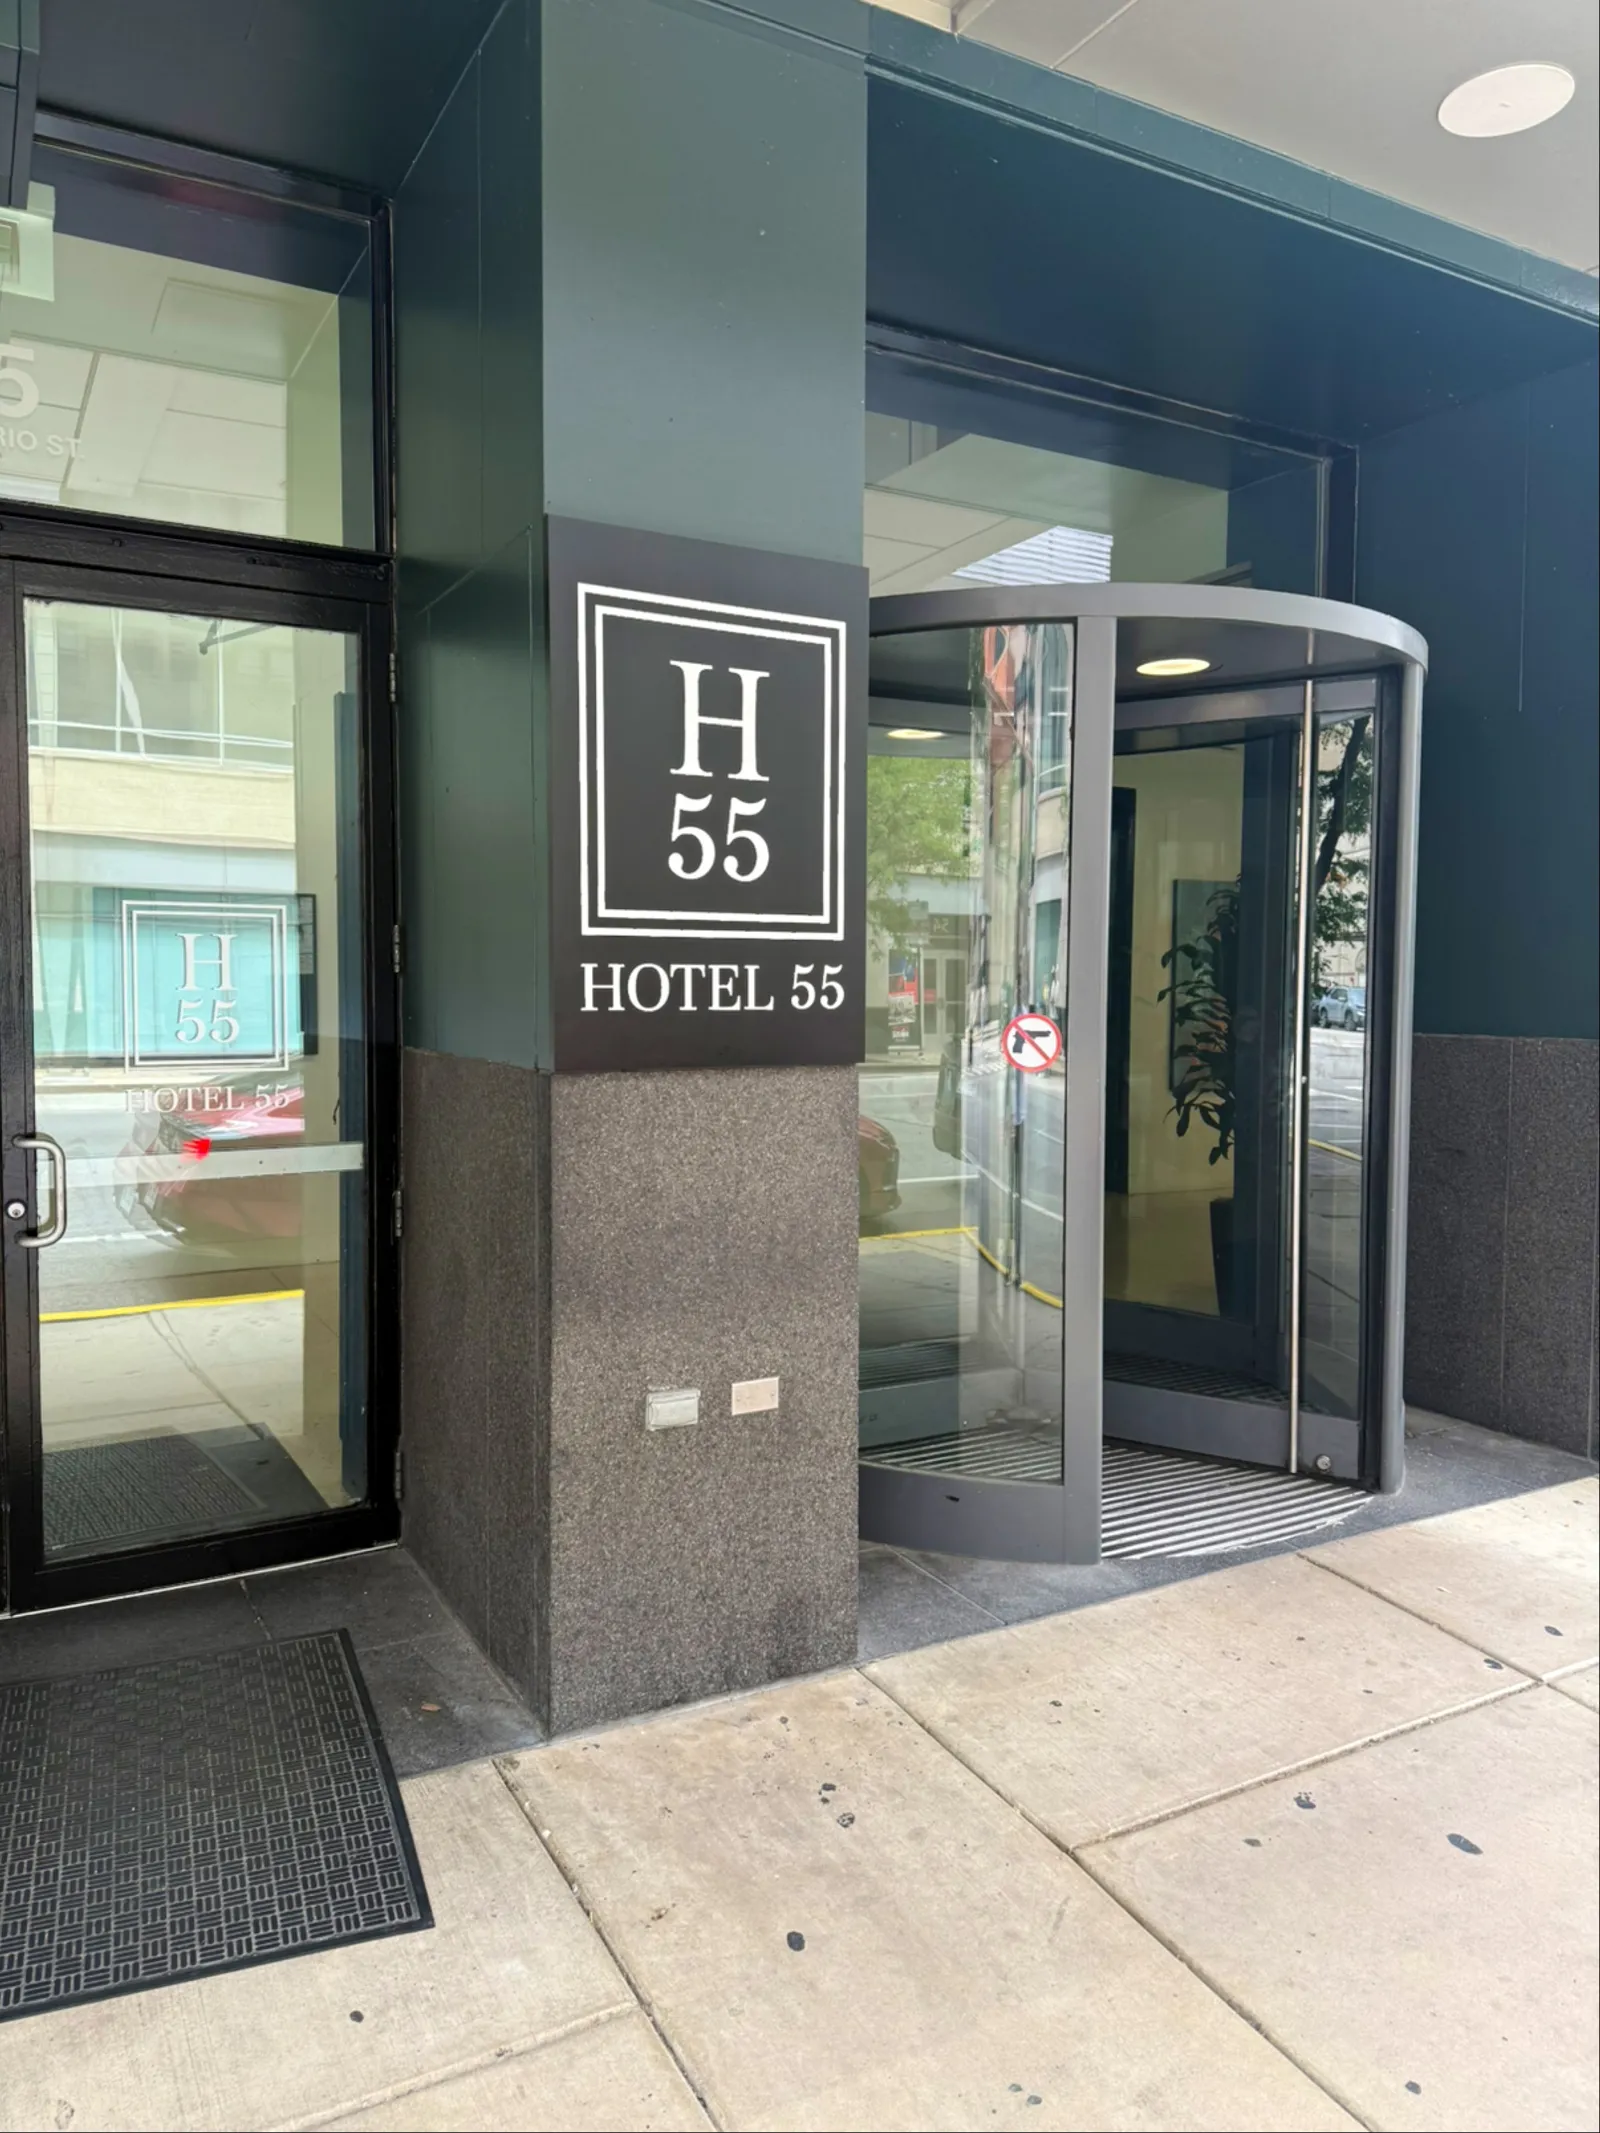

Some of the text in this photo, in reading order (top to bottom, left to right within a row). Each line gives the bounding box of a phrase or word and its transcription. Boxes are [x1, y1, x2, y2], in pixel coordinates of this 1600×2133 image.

[670, 660, 770, 781] H
[668, 793, 770, 882] 55
[175, 932, 239, 991] H
[580, 963, 774, 1012] HOTEL
[790, 963, 845, 1010] 55
[175, 998, 240, 1043] 55
[125, 1083, 290, 1114] HOTEL 55
